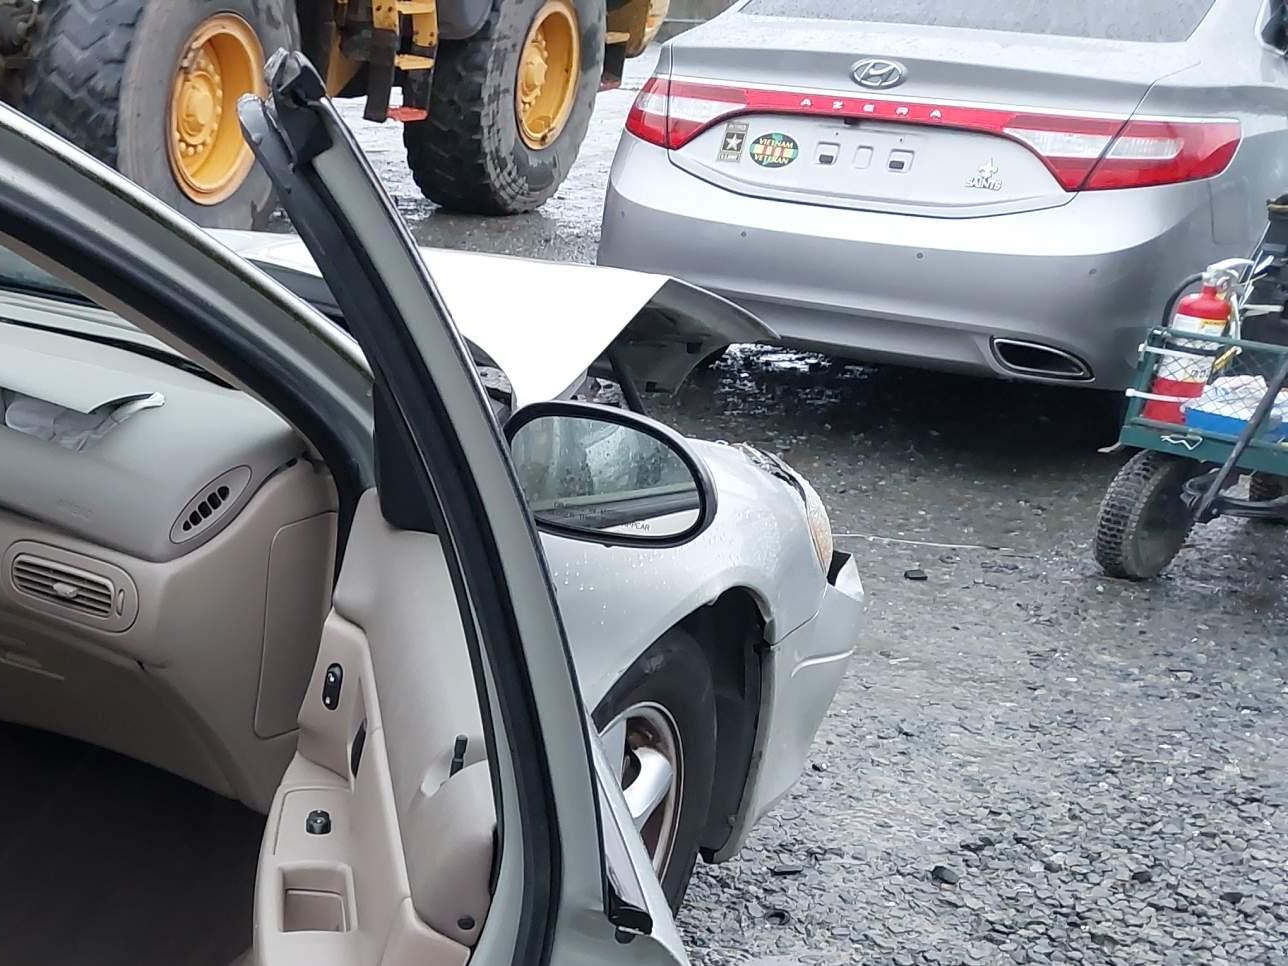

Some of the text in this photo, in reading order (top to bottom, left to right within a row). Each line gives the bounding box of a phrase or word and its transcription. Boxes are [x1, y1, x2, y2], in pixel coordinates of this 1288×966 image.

[800, 98, 942, 119] AZERA
[758, 137, 794, 149] VIETNAM
[754, 153, 790, 165] VETERAN
[964, 176, 1003, 191] SAINTS
